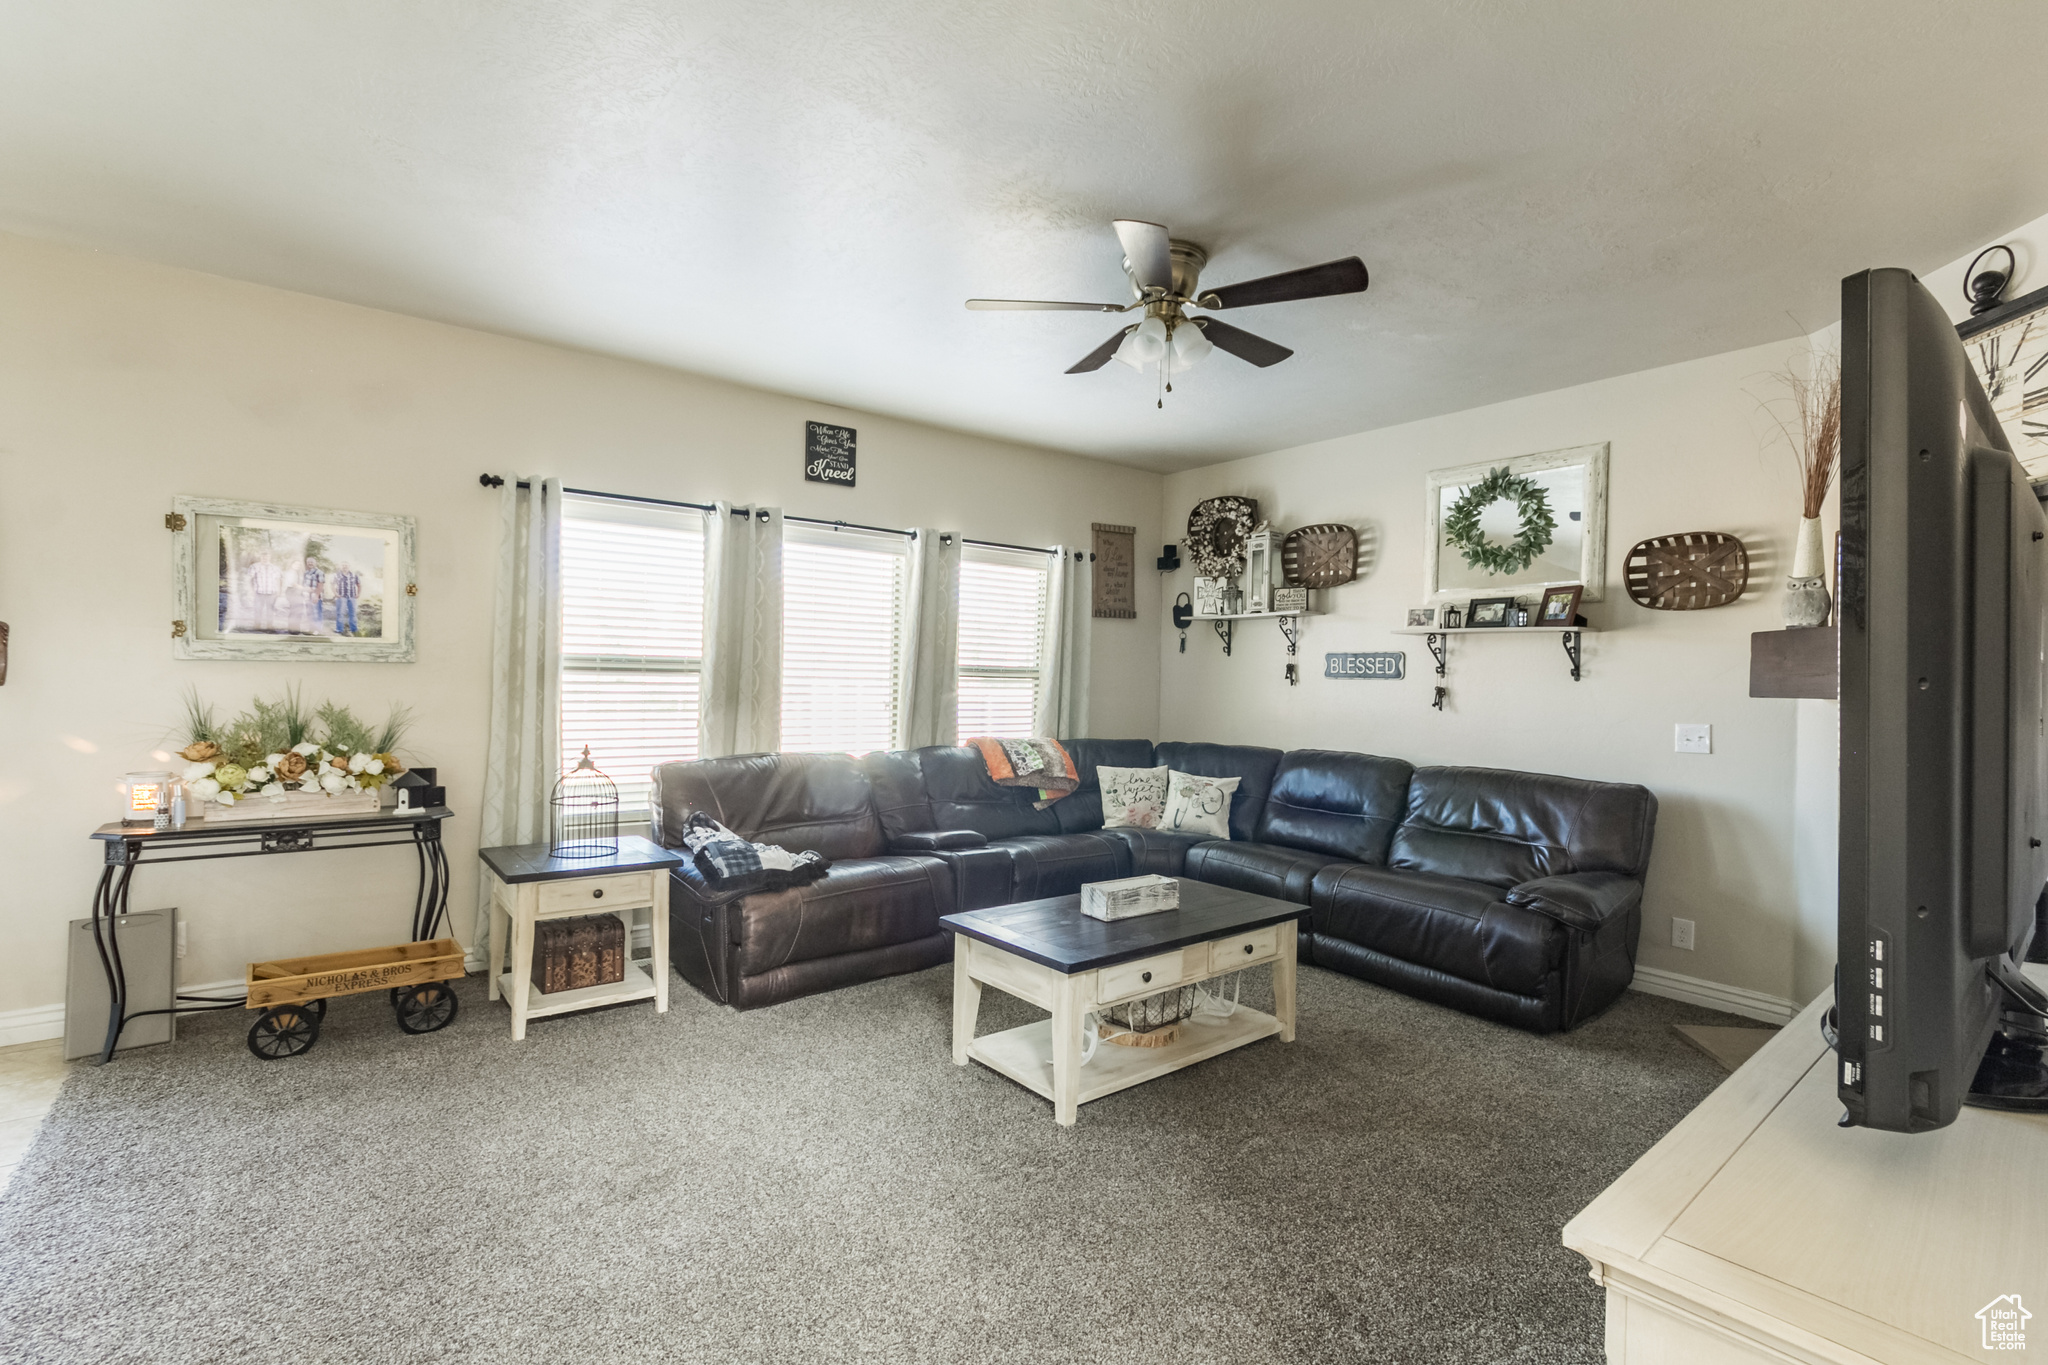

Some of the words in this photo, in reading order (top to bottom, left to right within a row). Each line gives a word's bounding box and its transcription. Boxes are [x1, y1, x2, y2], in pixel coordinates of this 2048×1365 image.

[810, 424, 834, 435] When
[834, 429, 851, 439] Life
[810, 444, 830, 454] More
[816, 434, 838, 445] Gives
[839, 437, 856, 449] You
[807, 458, 855, 481] Kneel
[829, 460, 849, 469] STAND
[1275, 588, 1291, 601] God
[1330, 657, 1395, 674] BLESSED
[1126, 772, 1152, 785] home
[306, 970, 367, 988] NICHOLAS
[370, 970, 379, 978] &
[382, 964, 412, 977] BROS
[335, 976, 388, 992] EXPRESS
